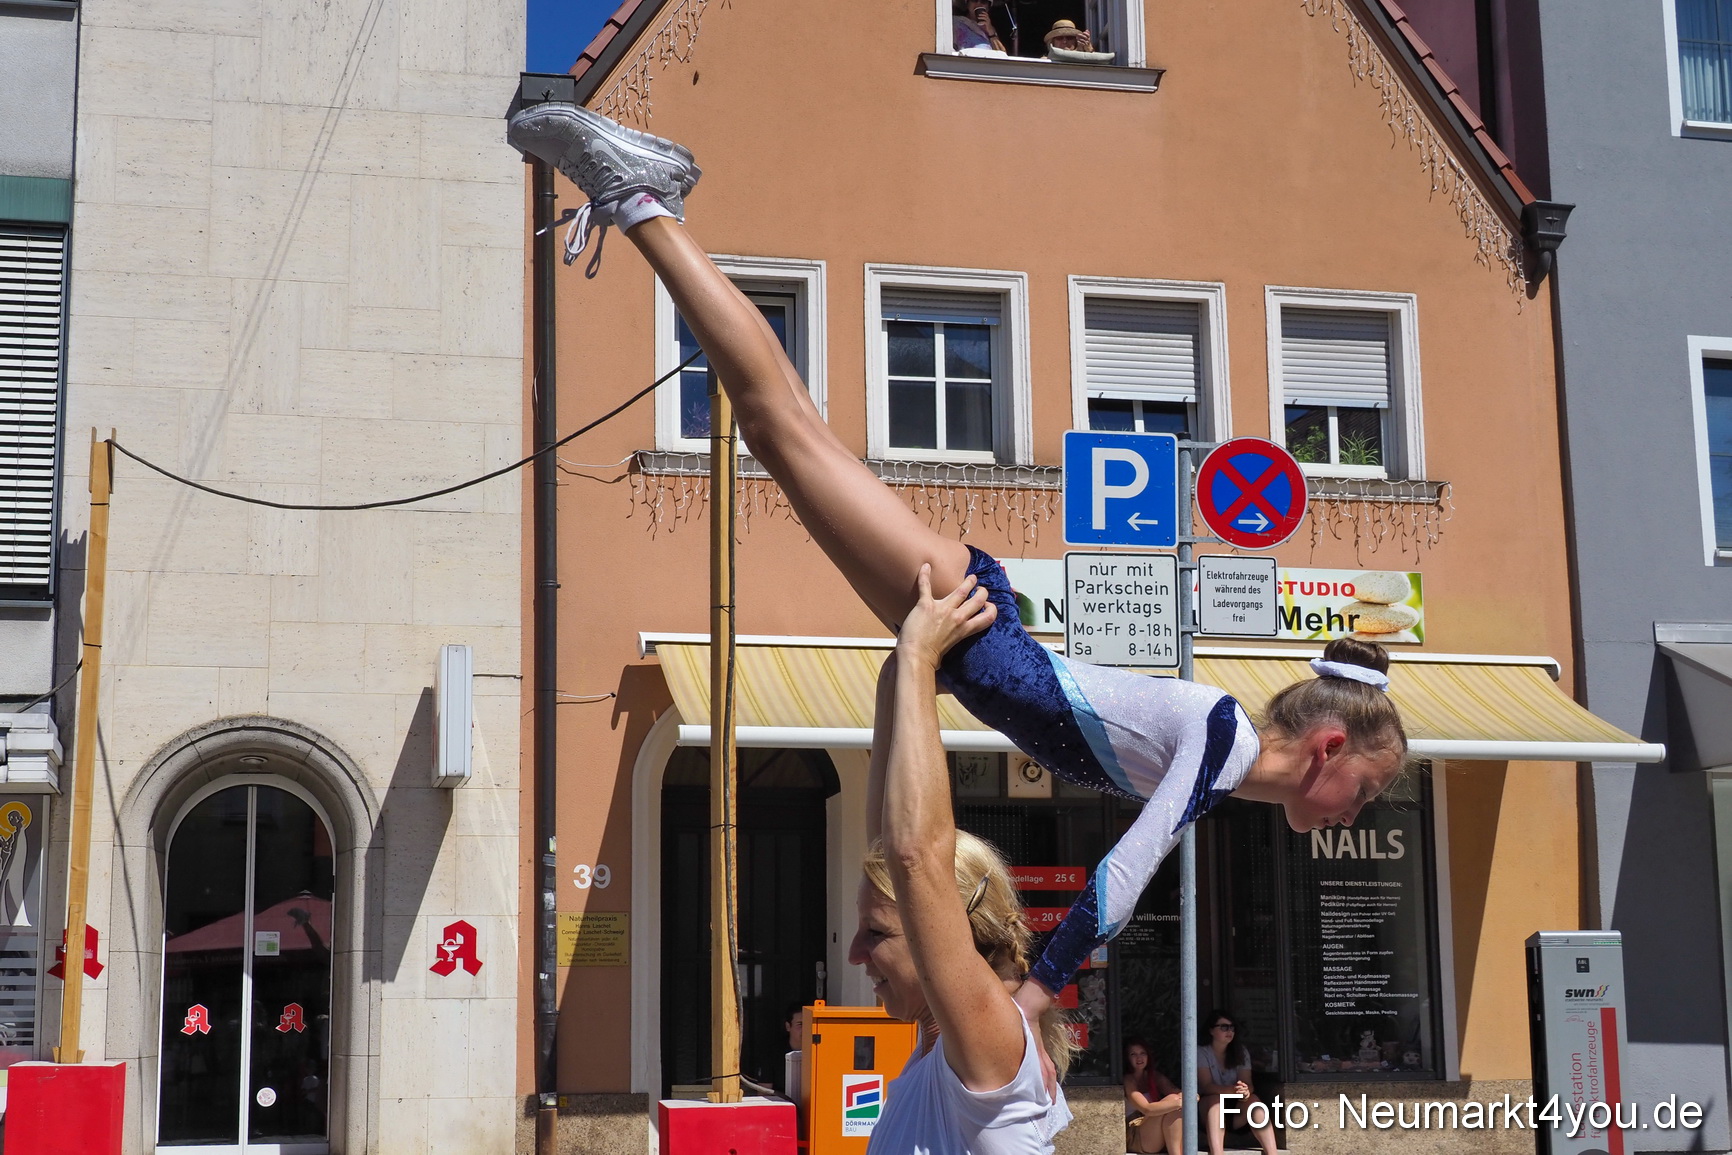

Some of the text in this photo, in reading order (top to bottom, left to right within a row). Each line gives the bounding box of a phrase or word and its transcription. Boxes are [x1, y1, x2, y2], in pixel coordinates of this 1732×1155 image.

[1092, 447, 1150, 530] P
[1090, 562, 1154, 577] nur mit
[1206, 570, 1269, 584] Elektrofahrzeuge
[1074, 580, 1169, 596] Parkschein
[1214, 584, 1262, 594] während des
[1082, 599, 1162, 618] werktags
[1212, 598, 1264, 611] Ladevorgangs
[1232, 613, 1246, 622] frei
[1278, 606, 1361, 633] Mehr
[1074, 642, 1092, 656] Sa
[1311, 828, 1405, 860] NAILS
[573, 864, 611, 890] 39
[1055, 873, 1066, 882] 25
[1069, 874, 1076, 882] €
[1042, 912, 1053, 922] 20
[1565, 988, 1595, 998] swn
